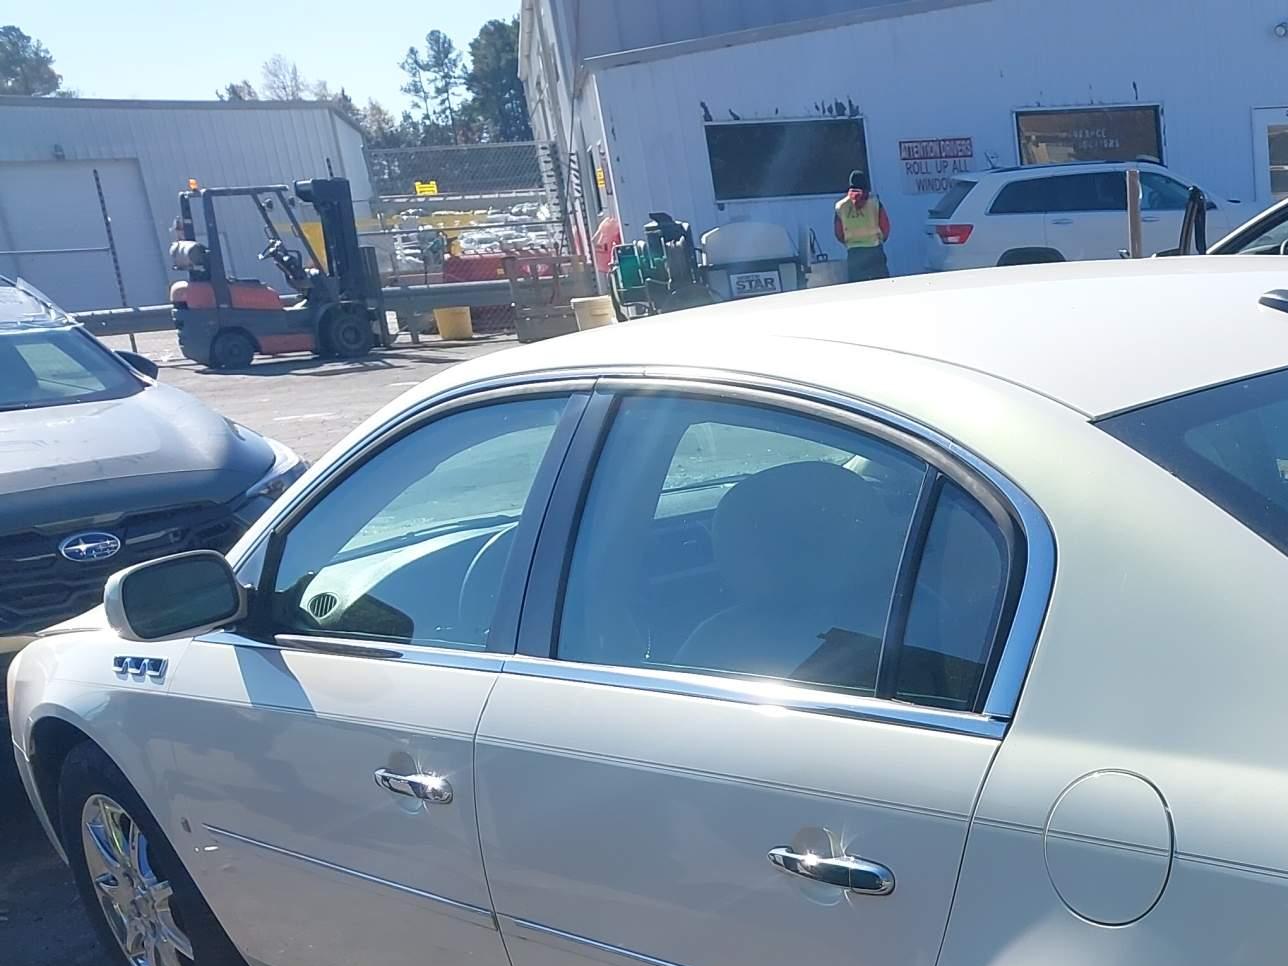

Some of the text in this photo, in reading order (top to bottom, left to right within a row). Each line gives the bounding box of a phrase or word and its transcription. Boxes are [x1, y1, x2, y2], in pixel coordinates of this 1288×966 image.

[902, 139, 971, 158] ATTENTION DRIVERS
[905, 159, 970, 175] ROLL UP ALL
[736, 278, 777, 290] STAR
